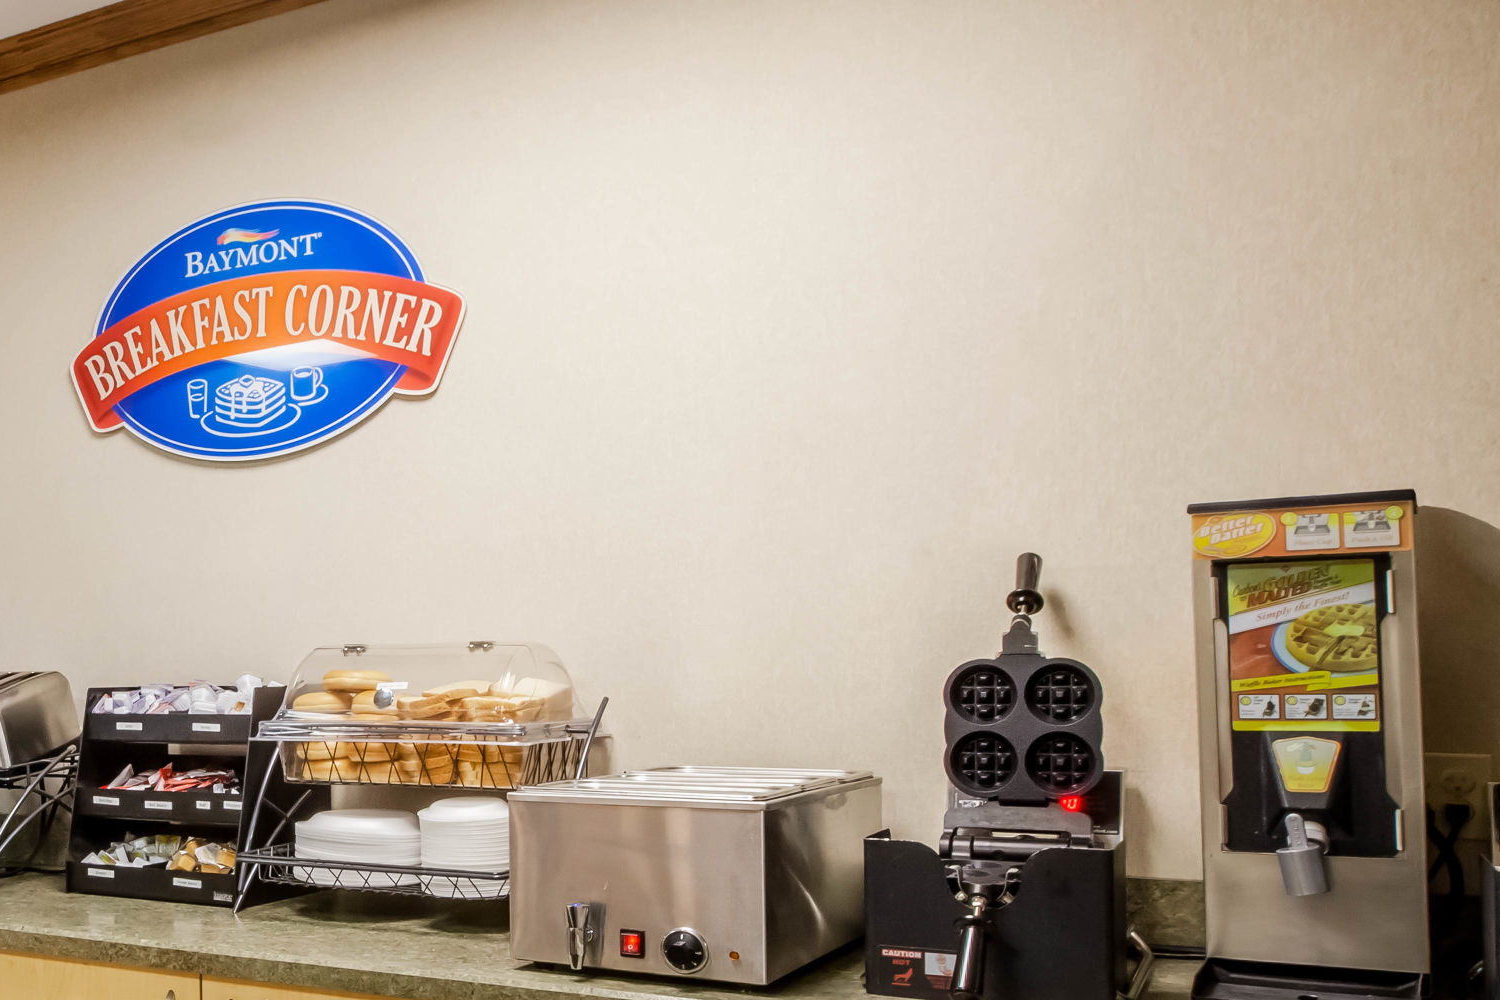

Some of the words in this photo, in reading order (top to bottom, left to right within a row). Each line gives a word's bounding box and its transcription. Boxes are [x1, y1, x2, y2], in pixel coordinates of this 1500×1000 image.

[185, 233, 315, 278] BAYMONT
[84, 286, 273, 401] BREAKFAST
[285, 284, 443, 357] CORNER
[1256, 606, 1292, 621] Simply
[1295, 601, 1311, 612] the
[881, 948, 922, 959] CAUTION
